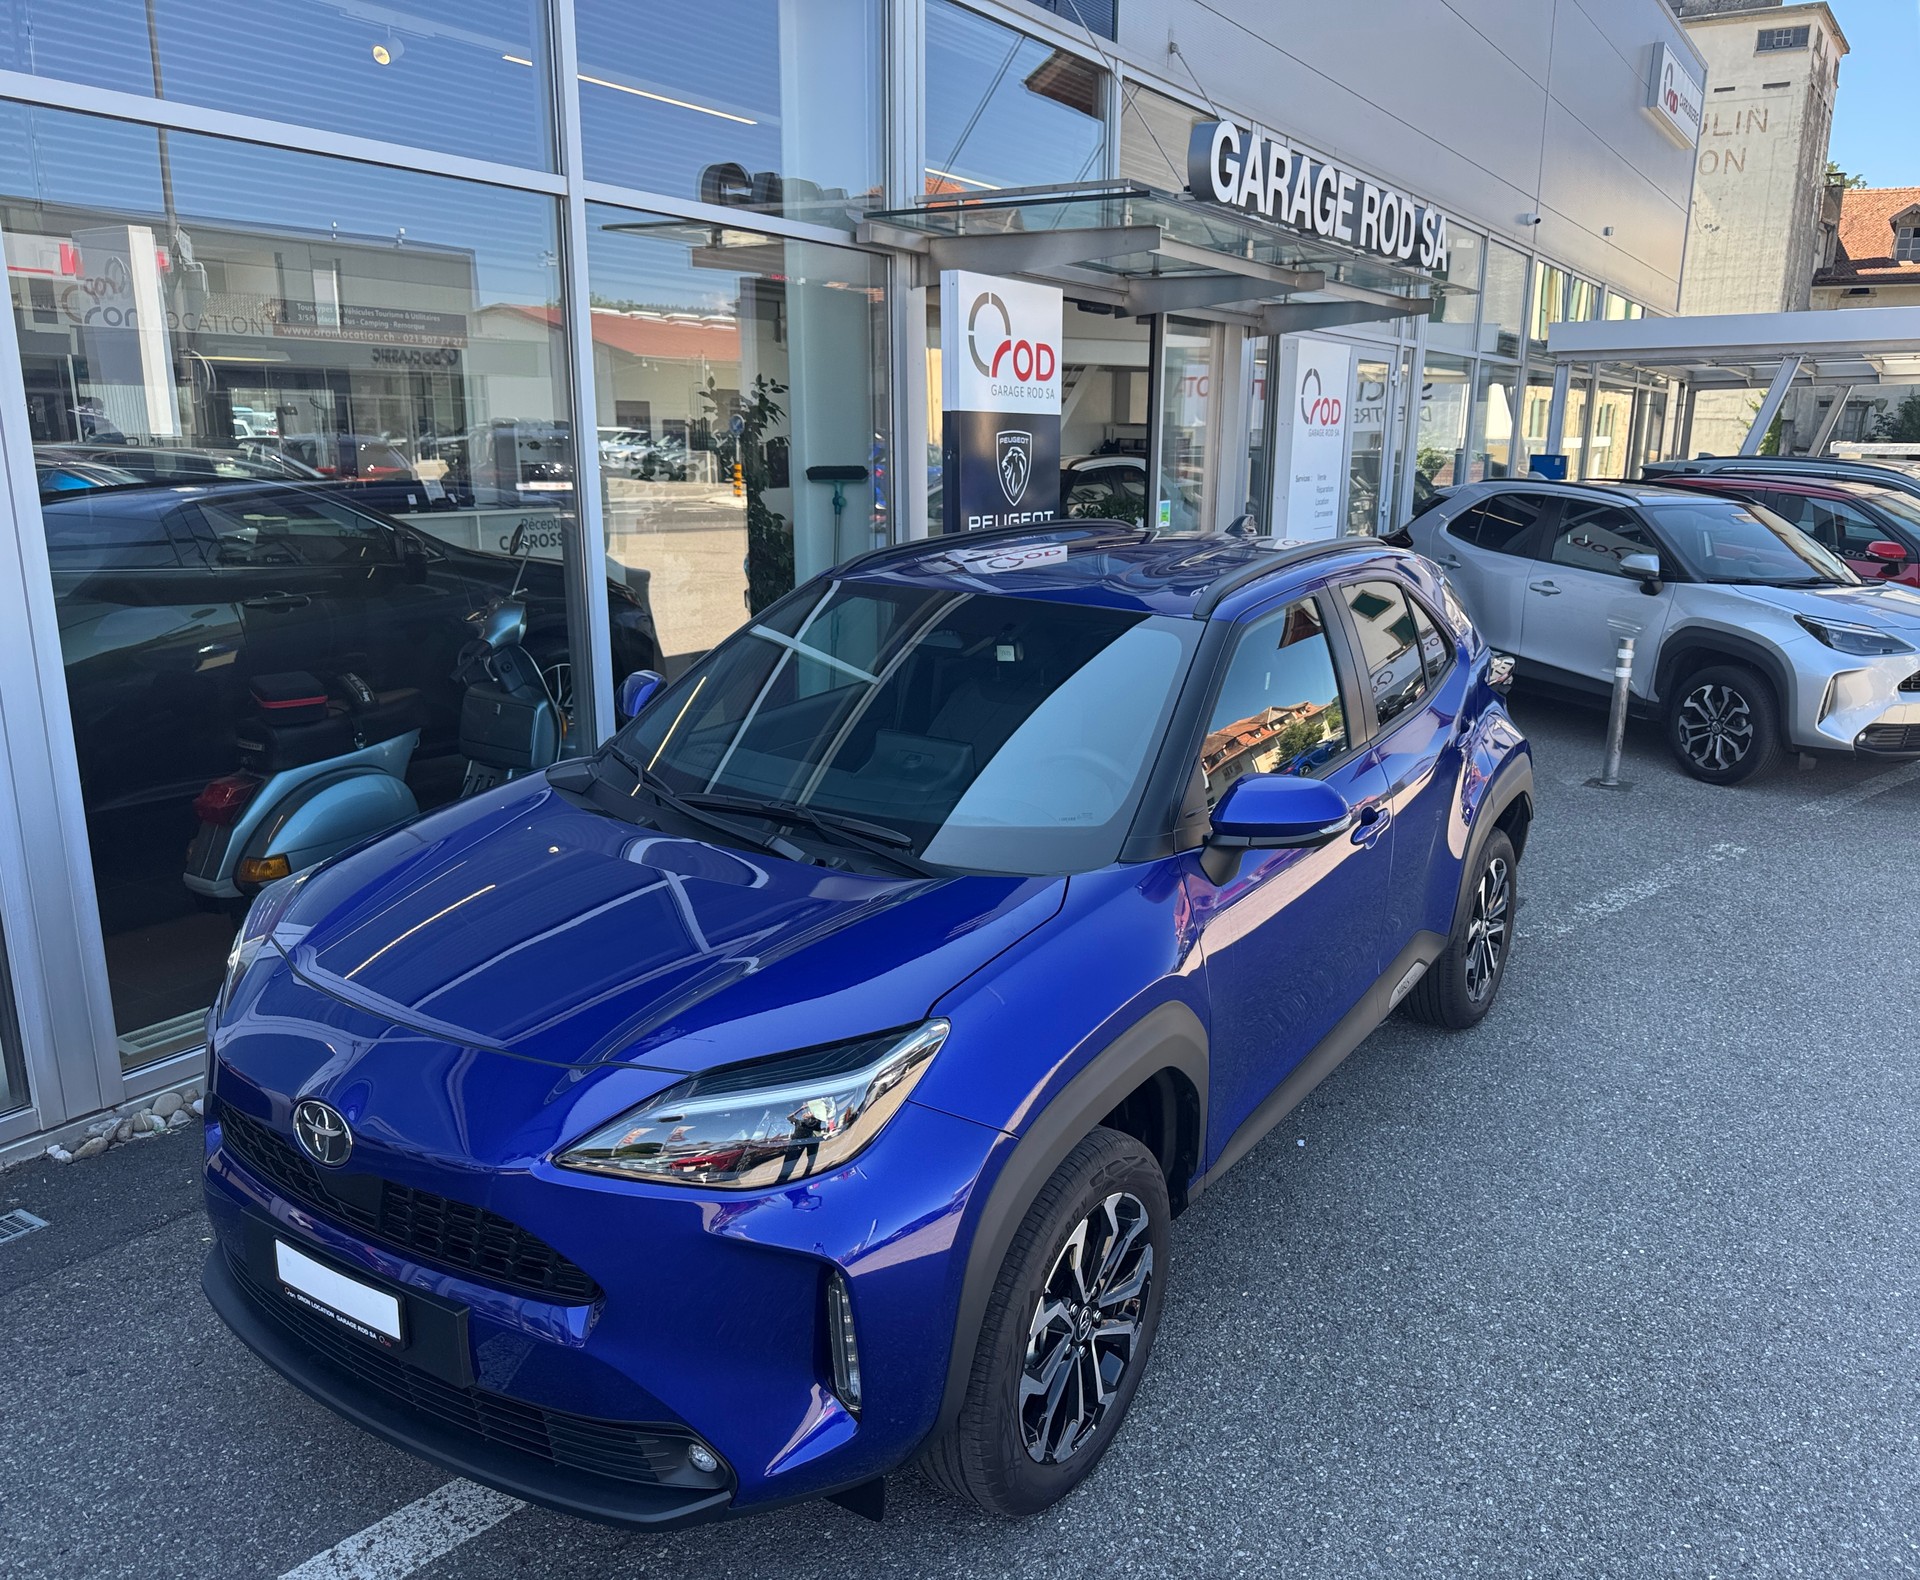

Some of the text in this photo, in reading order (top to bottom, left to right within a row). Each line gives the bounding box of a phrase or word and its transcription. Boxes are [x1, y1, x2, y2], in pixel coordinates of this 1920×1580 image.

[1210, 120, 1448, 272] GARAGE ROD SA
[296, 303, 313, 312] Tous
[375, 309, 403, 319] Tourisme
[166, 312, 265, 335] OCATION
[360, 319, 389, 329] Camping
[403, 334, 419, 344] 021
[990, 384, 1055, 400] GARAGE ROD SA
[999, 436, 1029, 445] PEUGEOT
[499, 532, 563, 551] CRROSS
